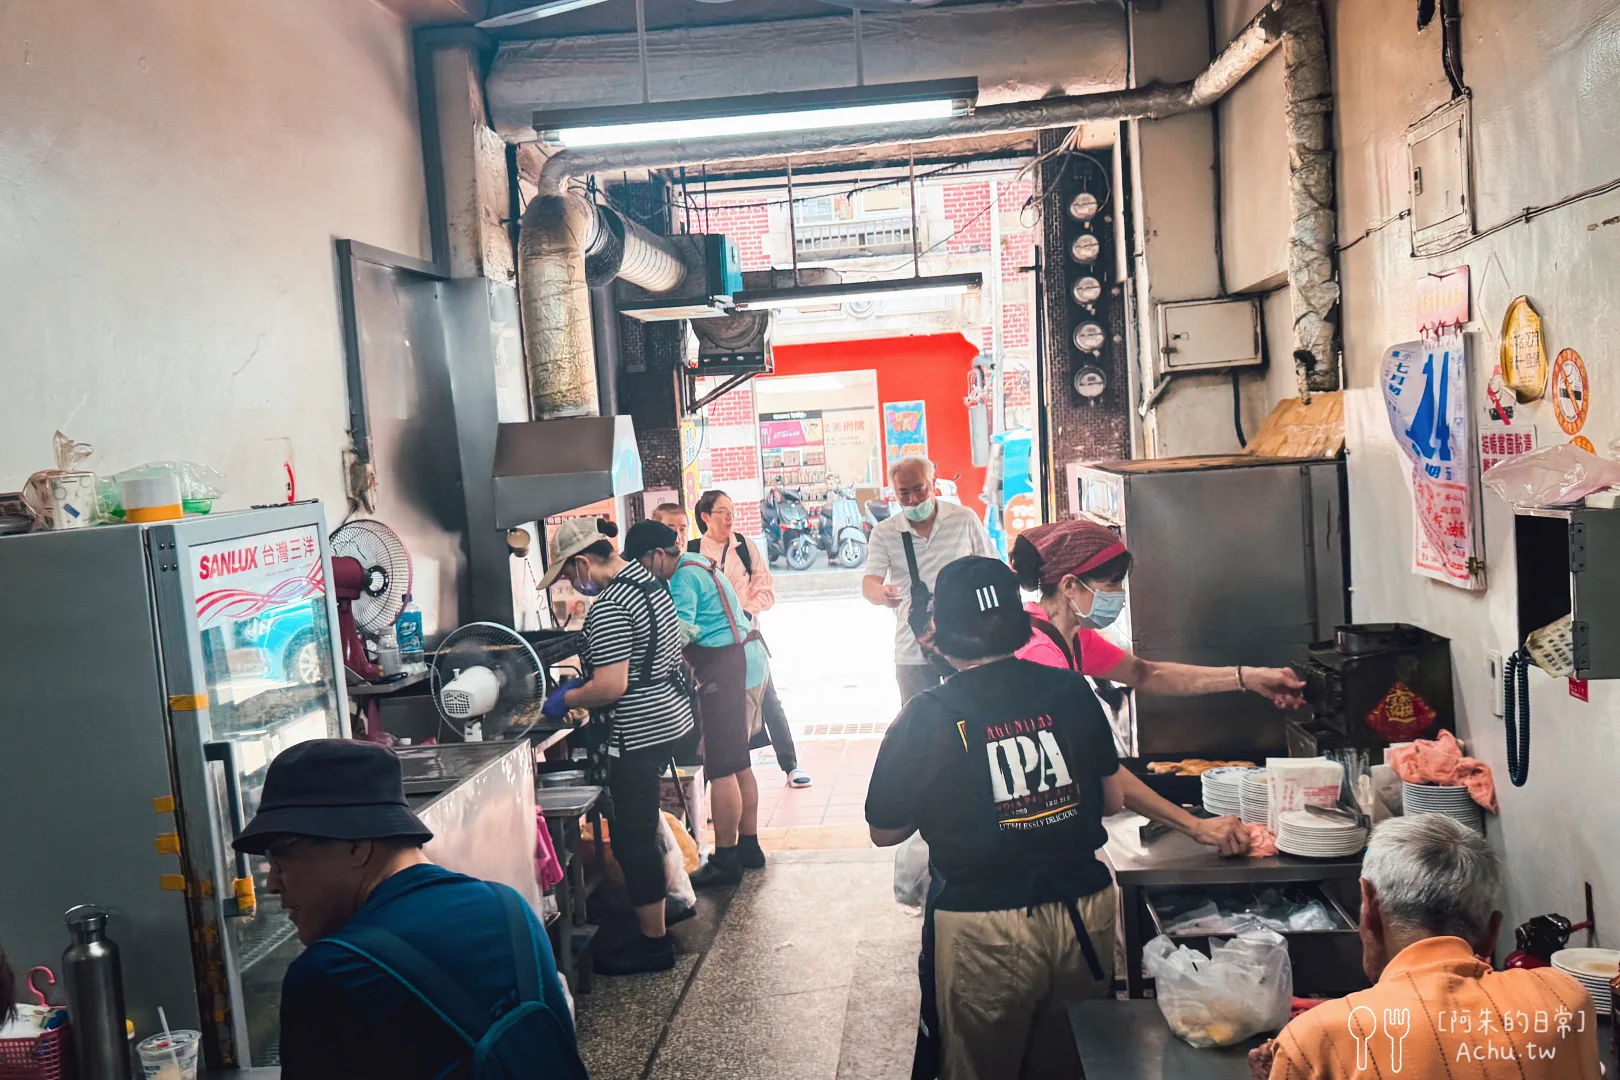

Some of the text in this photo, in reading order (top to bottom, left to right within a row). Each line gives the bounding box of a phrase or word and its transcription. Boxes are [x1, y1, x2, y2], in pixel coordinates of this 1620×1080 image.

[199, 545, 258, 580] SANLUX
[262, 536, 315, 567] 台灣三洋
